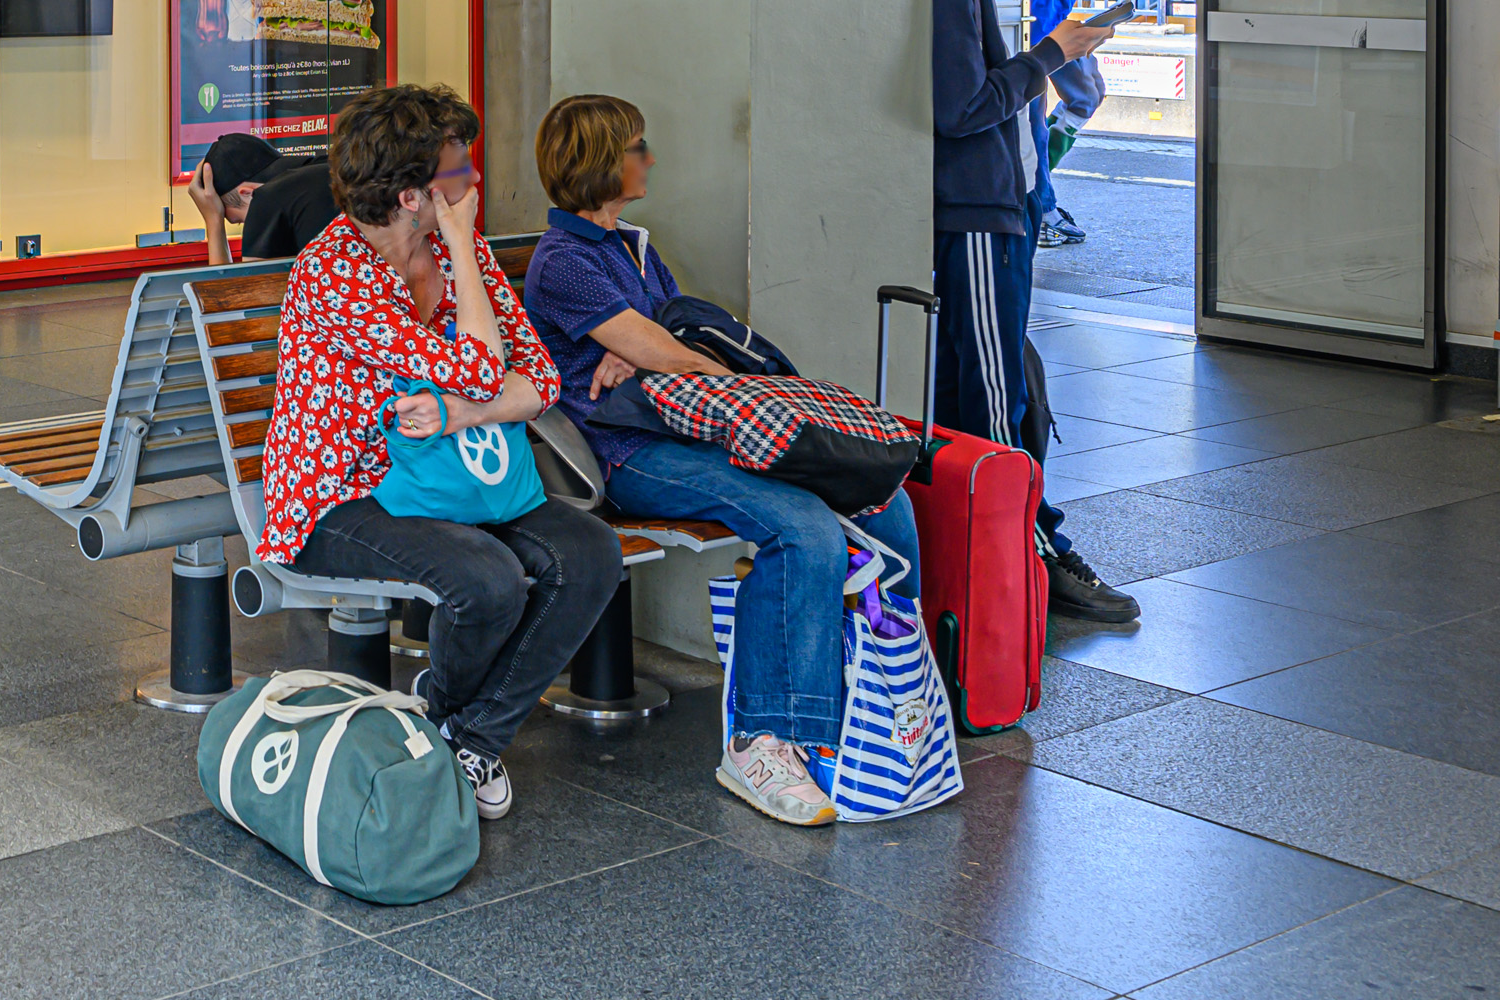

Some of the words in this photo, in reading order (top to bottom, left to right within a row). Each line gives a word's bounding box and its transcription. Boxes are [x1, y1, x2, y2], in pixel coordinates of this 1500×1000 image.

[250, 63, 275, 71] boissons
[275, 61, 296, 70] jusqu'à
[261, 126, 282, 134] VENTE
[302, 118, 325, 133] RELAY
